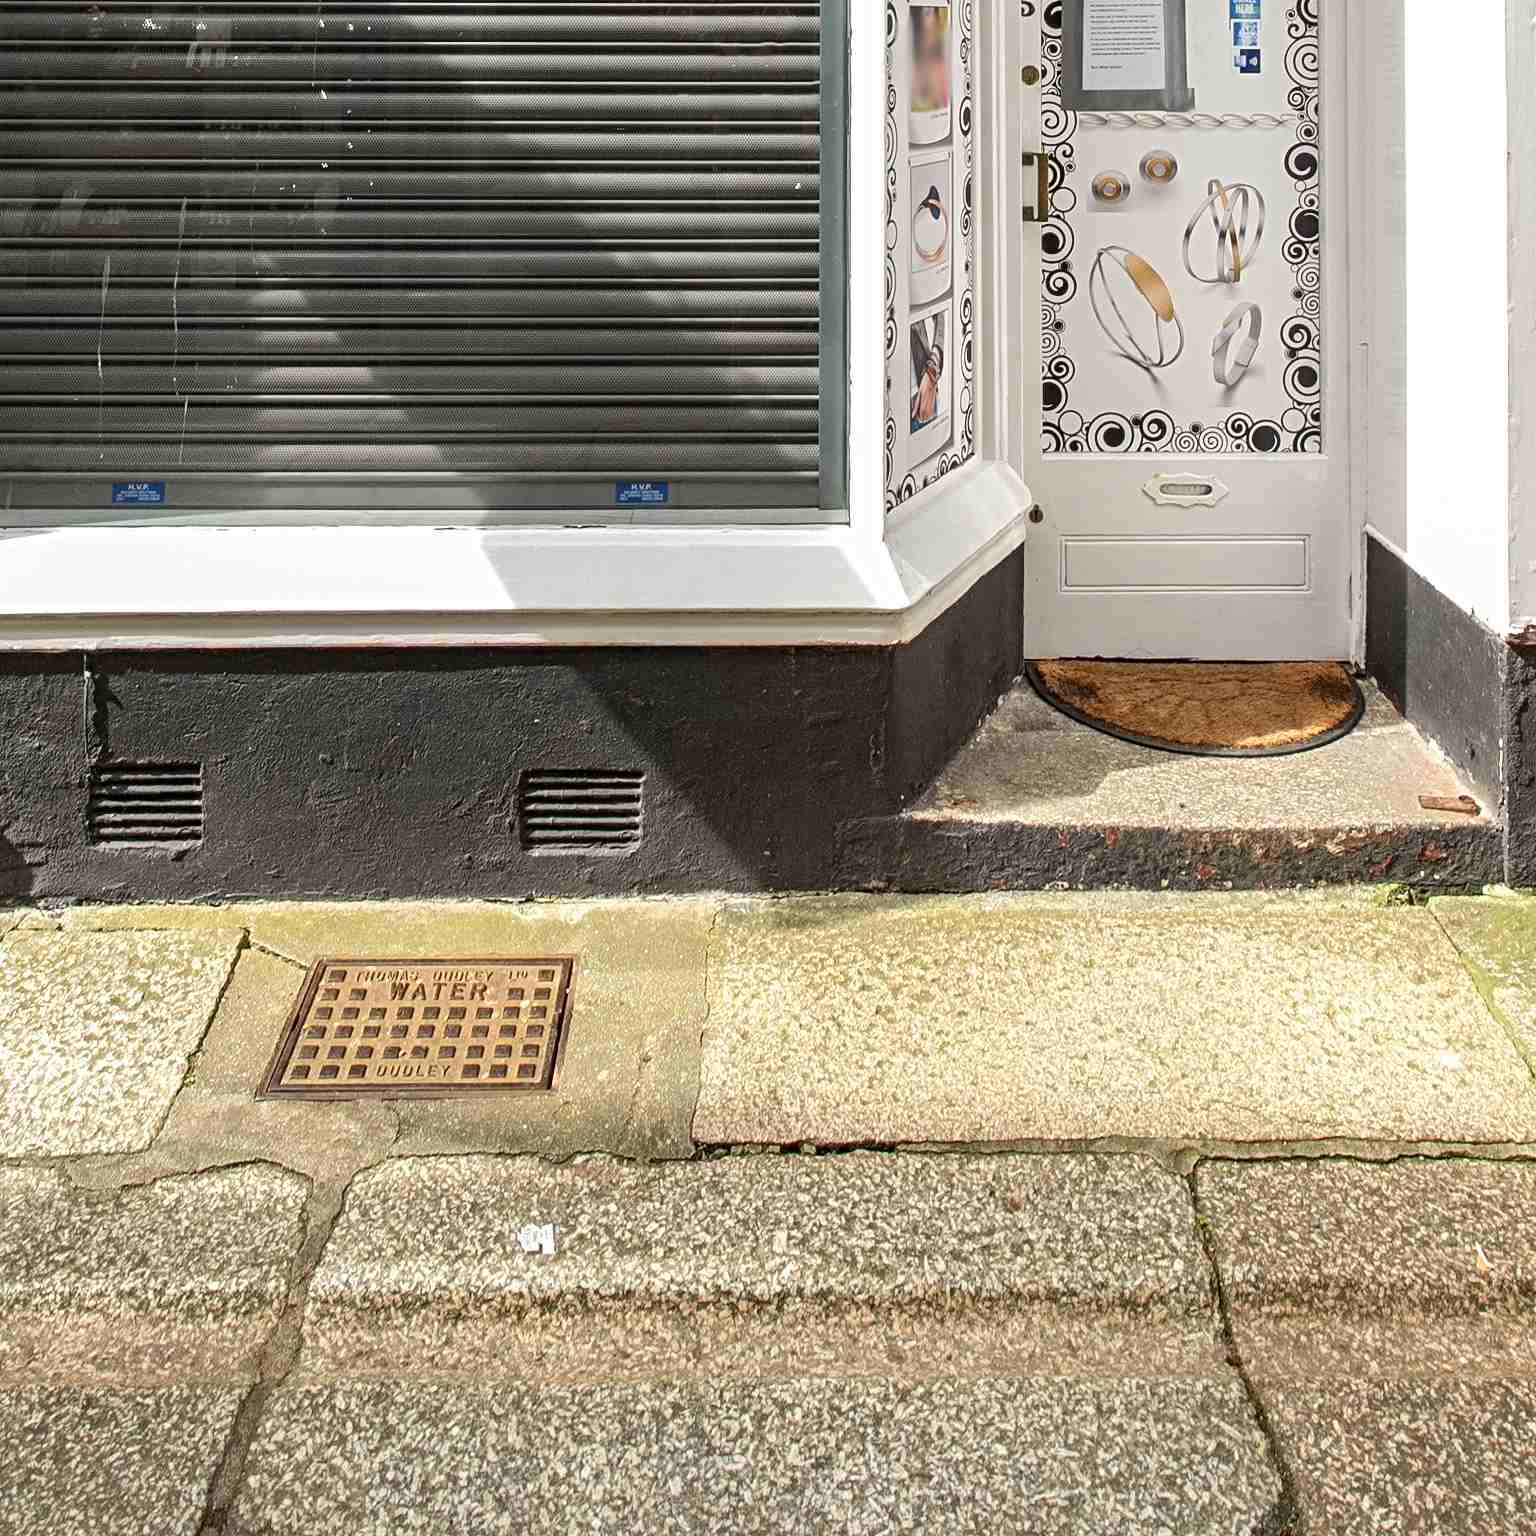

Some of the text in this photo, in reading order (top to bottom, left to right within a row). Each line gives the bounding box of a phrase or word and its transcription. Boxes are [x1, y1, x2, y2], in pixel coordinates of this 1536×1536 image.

[431, 969, 494, 982] DUDLEY
[389, 982, 488, 1002] WATER
[375, 1065, 452, 1078] DUDLEY
